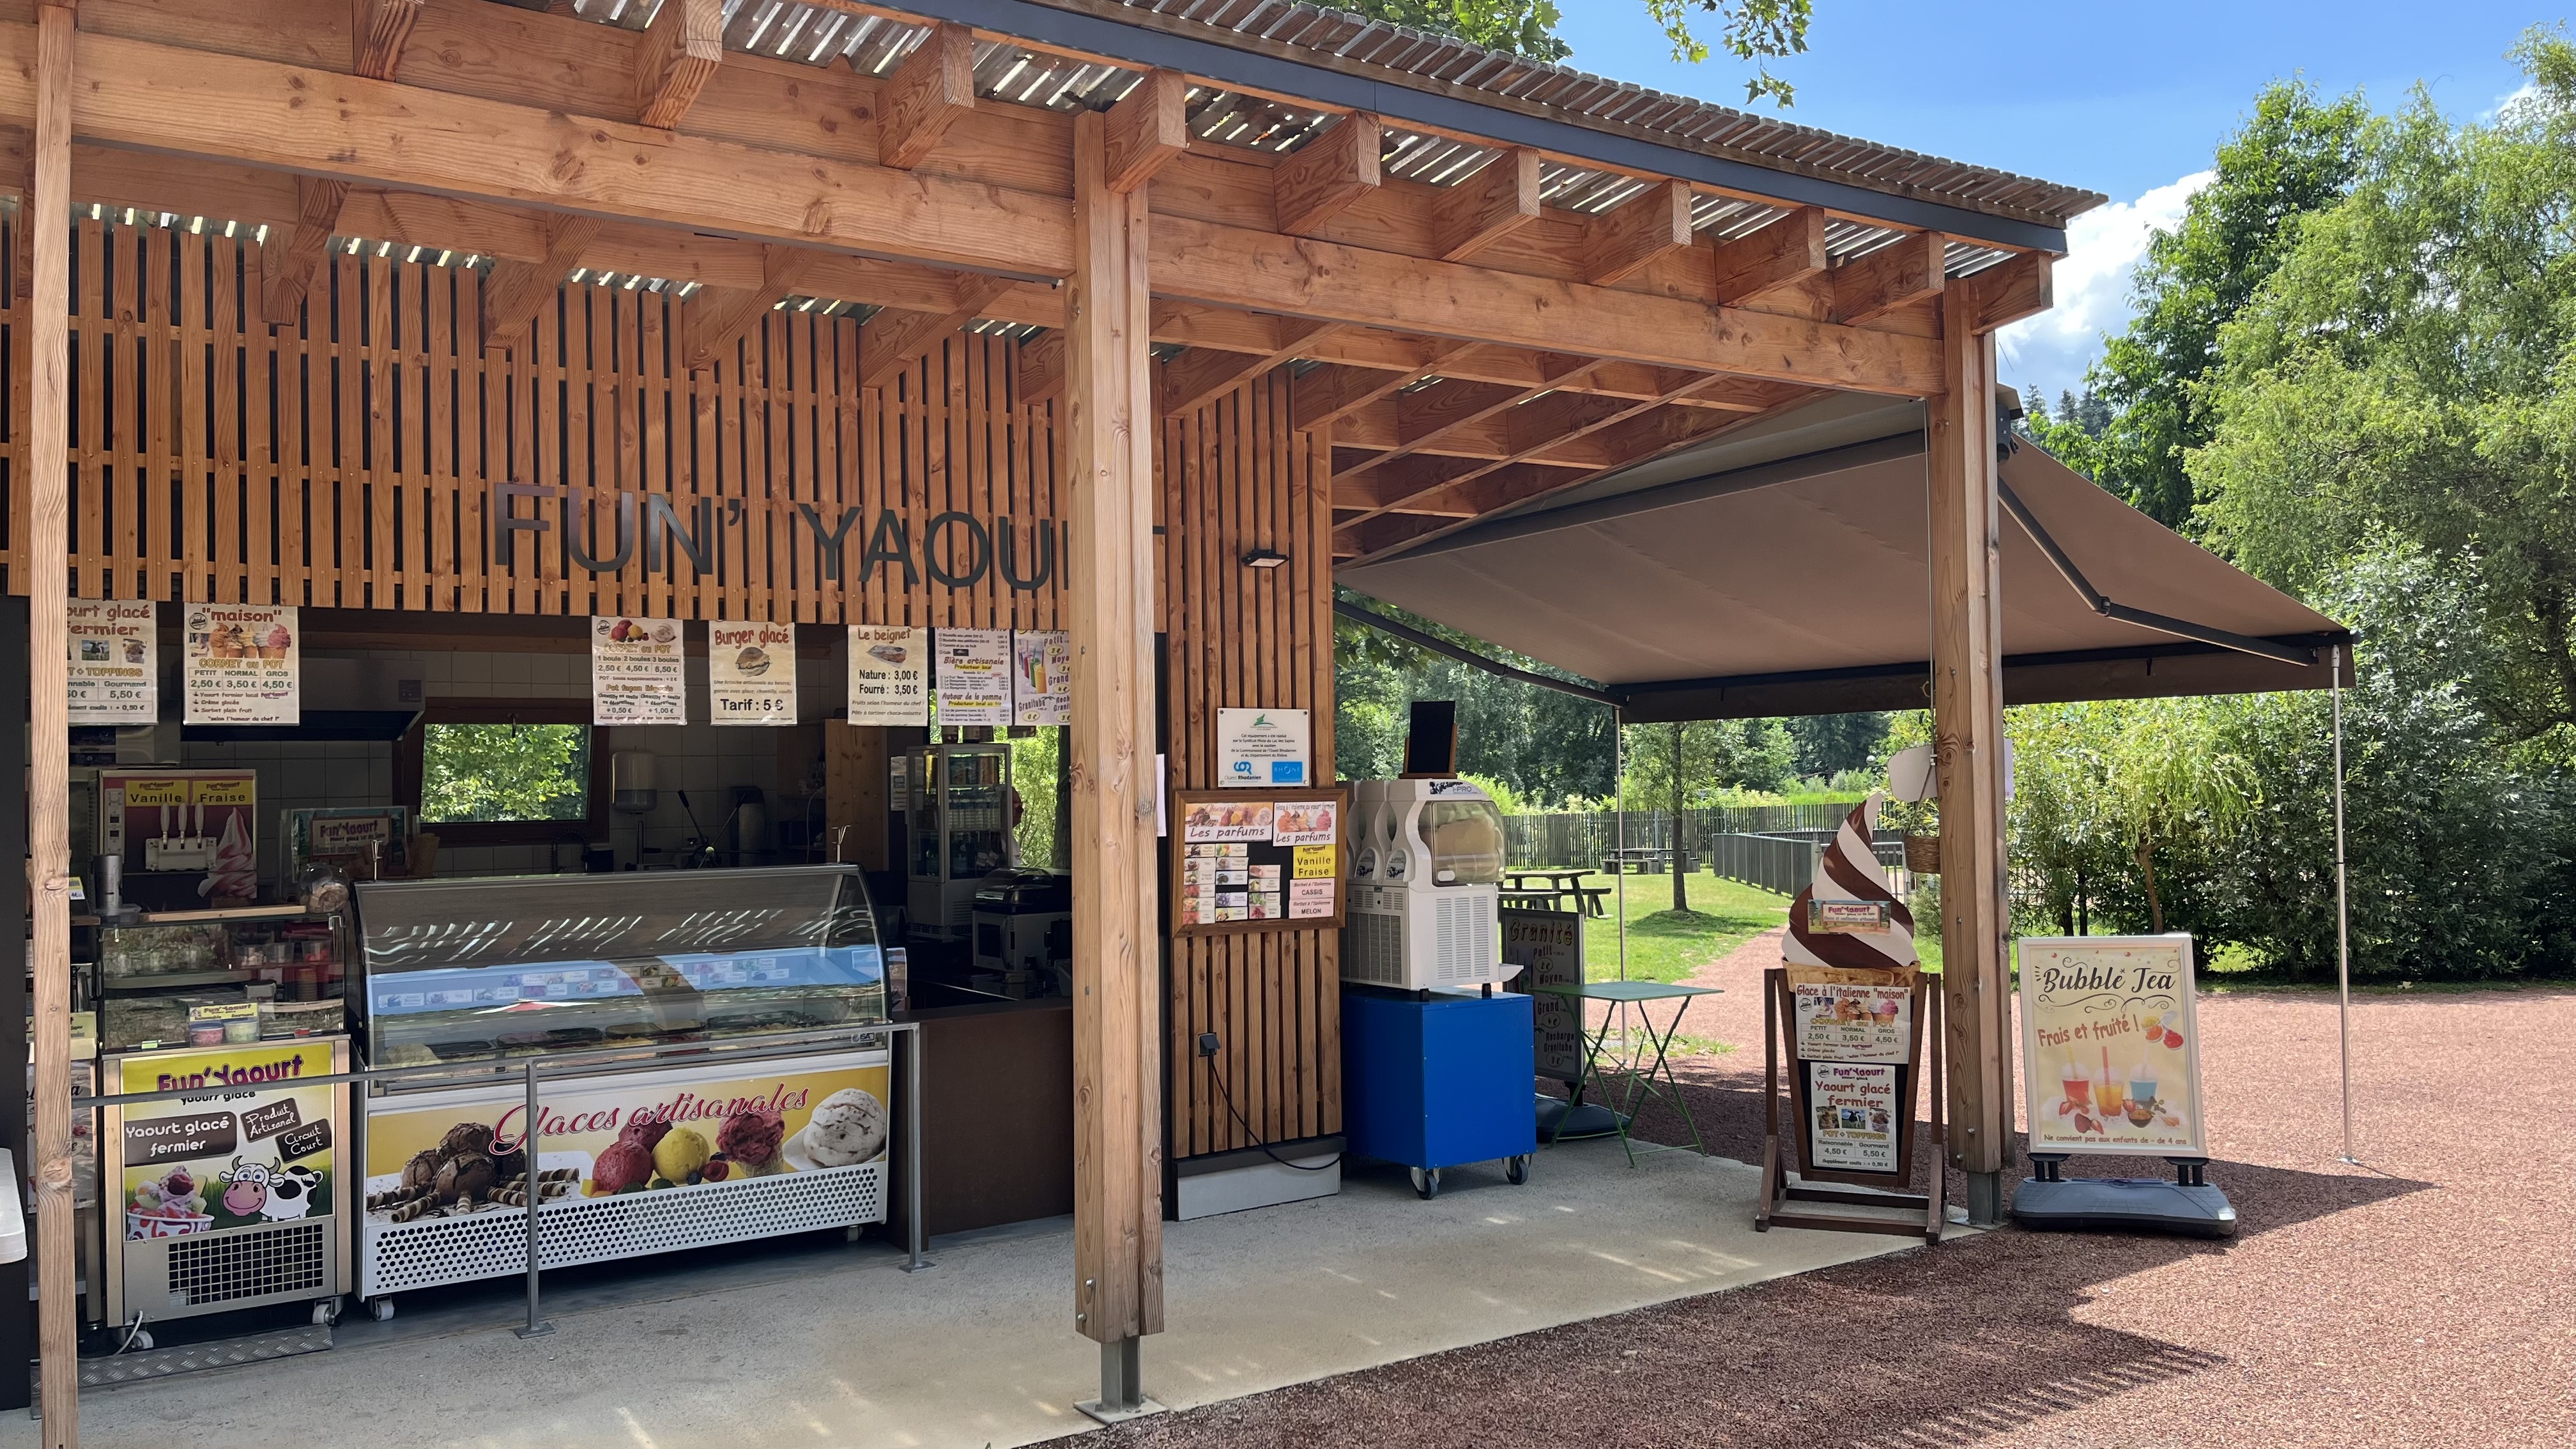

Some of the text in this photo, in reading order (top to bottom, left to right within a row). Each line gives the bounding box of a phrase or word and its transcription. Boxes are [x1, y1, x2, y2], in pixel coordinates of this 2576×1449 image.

[494, 482, 1069, 590] FUN' YAOU
[68, 604, 150, 621] ourt glacé
[202, 608, 282, 622] "maison"
[68, 623, 139, 636] ermier
[858, 627, 911, 643] Le beignet
[715, 625, 790, 649] Burger glacé
[654, 645, 671, 654] POT
[199, 658, 242, 668] CORNET
[263, 660, 284, 668] POT
[1052, 656, 1070, 664] Moye
[86, 667, 143, 677] TOPPINGS
[859, 670, 917, 682] Nature 3,00 €
[191, 680, 213, 689] 2,50
[1048, 674, 1068, 686] Grand
[110, 691, 133, 699] 5,50
[859, 684, 917, 696] Fourré 3,50 €
[720, 699, 783, 710] Tarif 5 €
[130, 793, 182, 802] Vanille
[200, 793, 245, 802] Fraise
[1190, 827, 1264, 839] Les parfums
[1276, 832, 1330, 843] Les parfums
[1298, 857, 1331, 866] Vanille
[1299, 868, 1329, 877] Fraise
[1509, 919, 1572, 946] Granité
[1540, 974, 1562, 985] Moyen
[2044, 967, 2176, 993] Bubble Tea
[1797, 985, 1908, 1000] Glace à l'italienne "maison"
[1538, 999, 1559, 1015] Grand
[2037, 1027, 2071, 1047] Frais
[2074, 1023, 2087, 1039] et
[2092, 1014, 2130, 1040] fruité
[157, 1054, 304, 1091] Fun'Yaourt
[1834, 1068, 1885, 1076] Fun'Yaourt
[1815, 1081, 1891, 1096] Yaourt glacé
[1828, 1095, 1883, 1107] fermier
[245, 1103, 291, 1125] Produit
[489, 1083, 810, 1156] Glaces artisanales
[126, 1116, 230, 1139] Yaourt glacé
[249, 1112, 296, 1139] Artisanal
[284, 1124, 322, 1146] Circuit
[1847, 1131, 1887, 1140] TOPPINGS
[150, 1138, 206, 1158] fermier
[290, 1137, 323, 1156] Court
